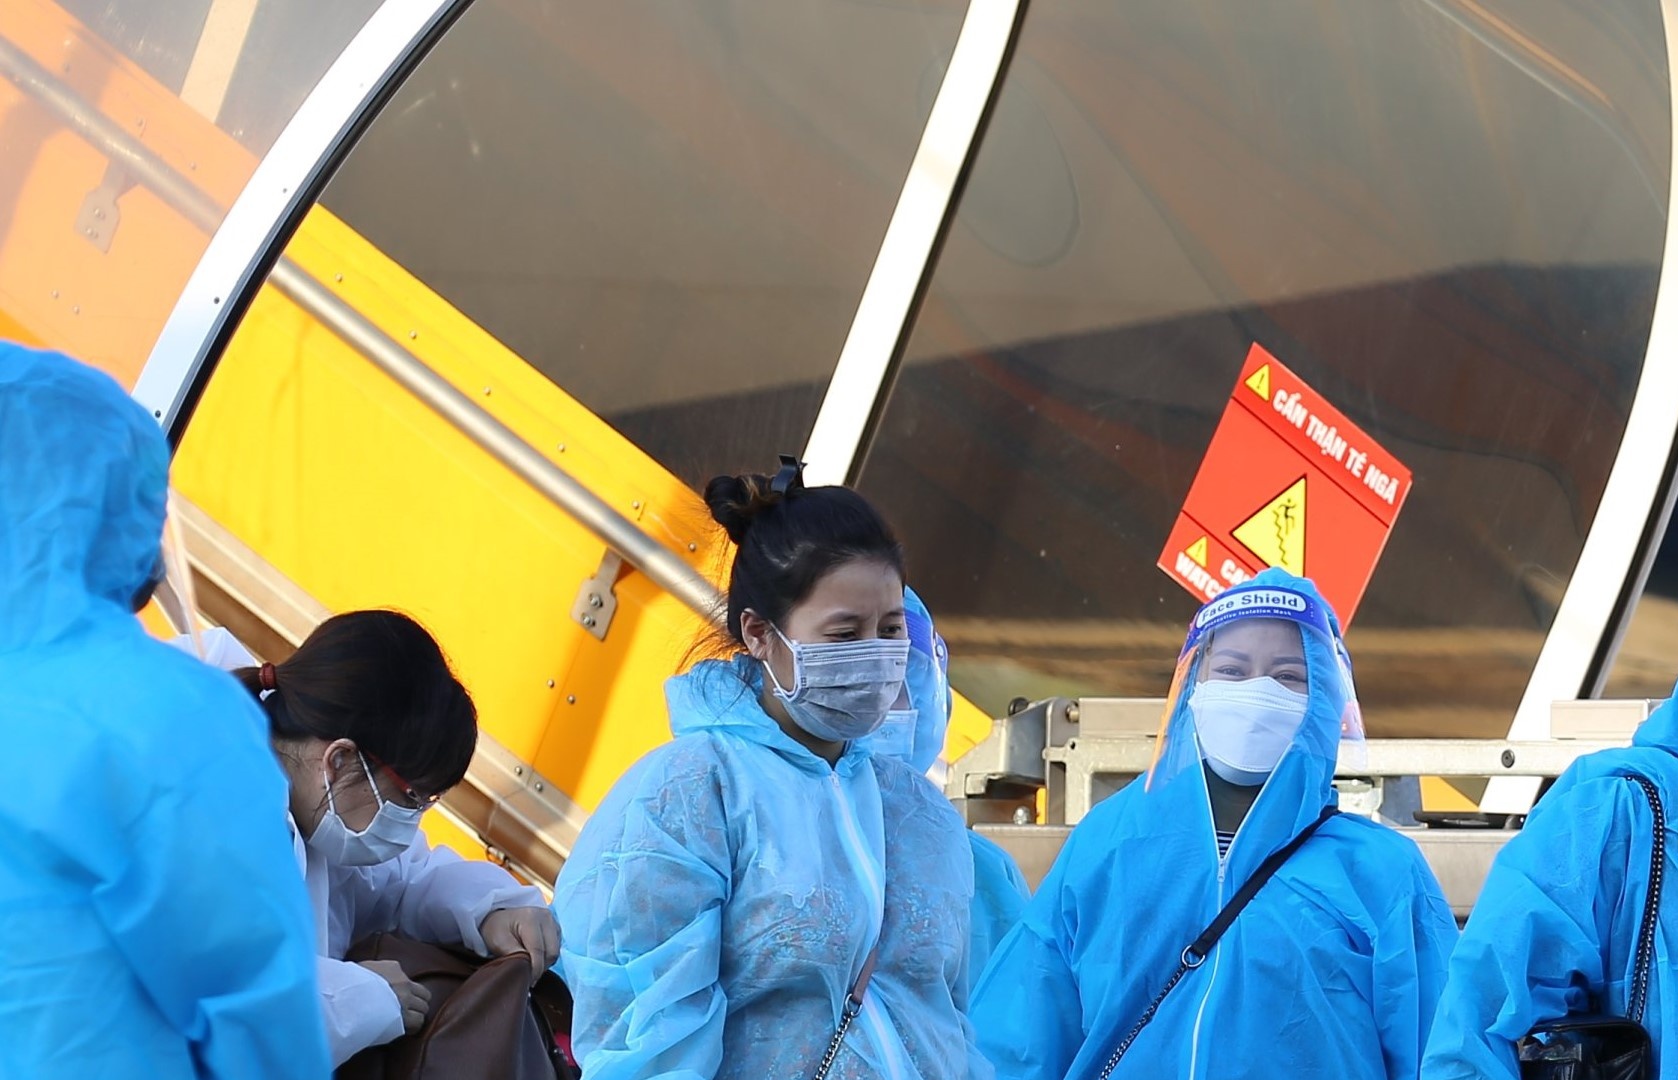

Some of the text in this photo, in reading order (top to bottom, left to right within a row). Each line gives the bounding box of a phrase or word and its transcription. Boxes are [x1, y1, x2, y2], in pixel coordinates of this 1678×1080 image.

[1305, 415, 1348, 462] THẬN
[1345, 447, 1368, 478] TÉ
[1202, 594, 1298, 622] Face Shield
